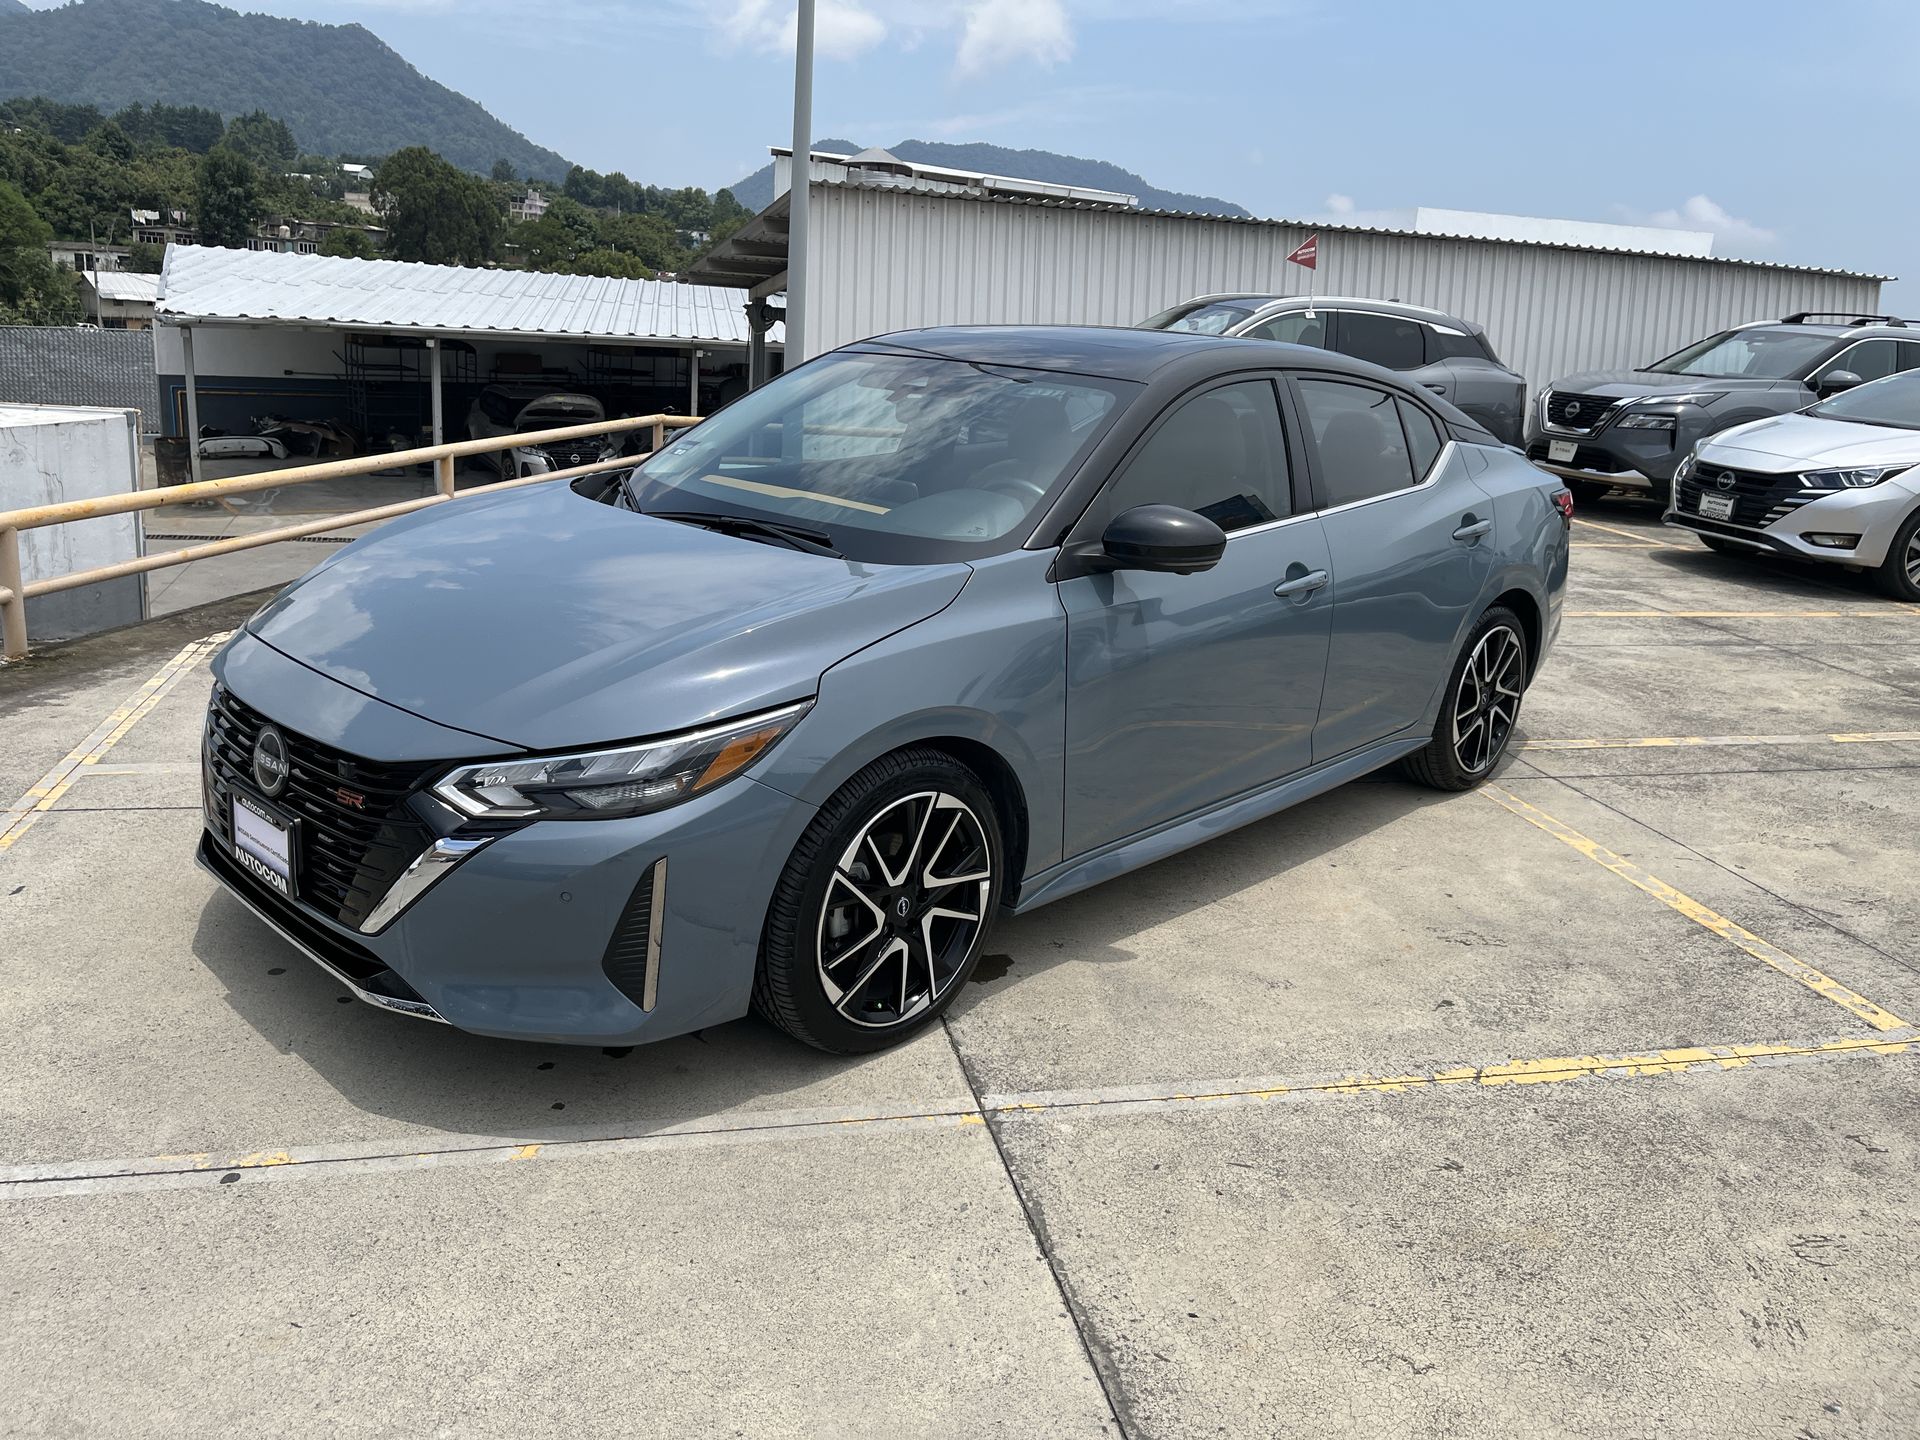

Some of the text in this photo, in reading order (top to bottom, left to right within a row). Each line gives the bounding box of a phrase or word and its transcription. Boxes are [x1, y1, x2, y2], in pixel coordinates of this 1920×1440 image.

[1698, 510, 1729, 521] AUTOCOM
[337, 787, 365, 809] SR
[235, 845, 288, 895] AUTOCOM
